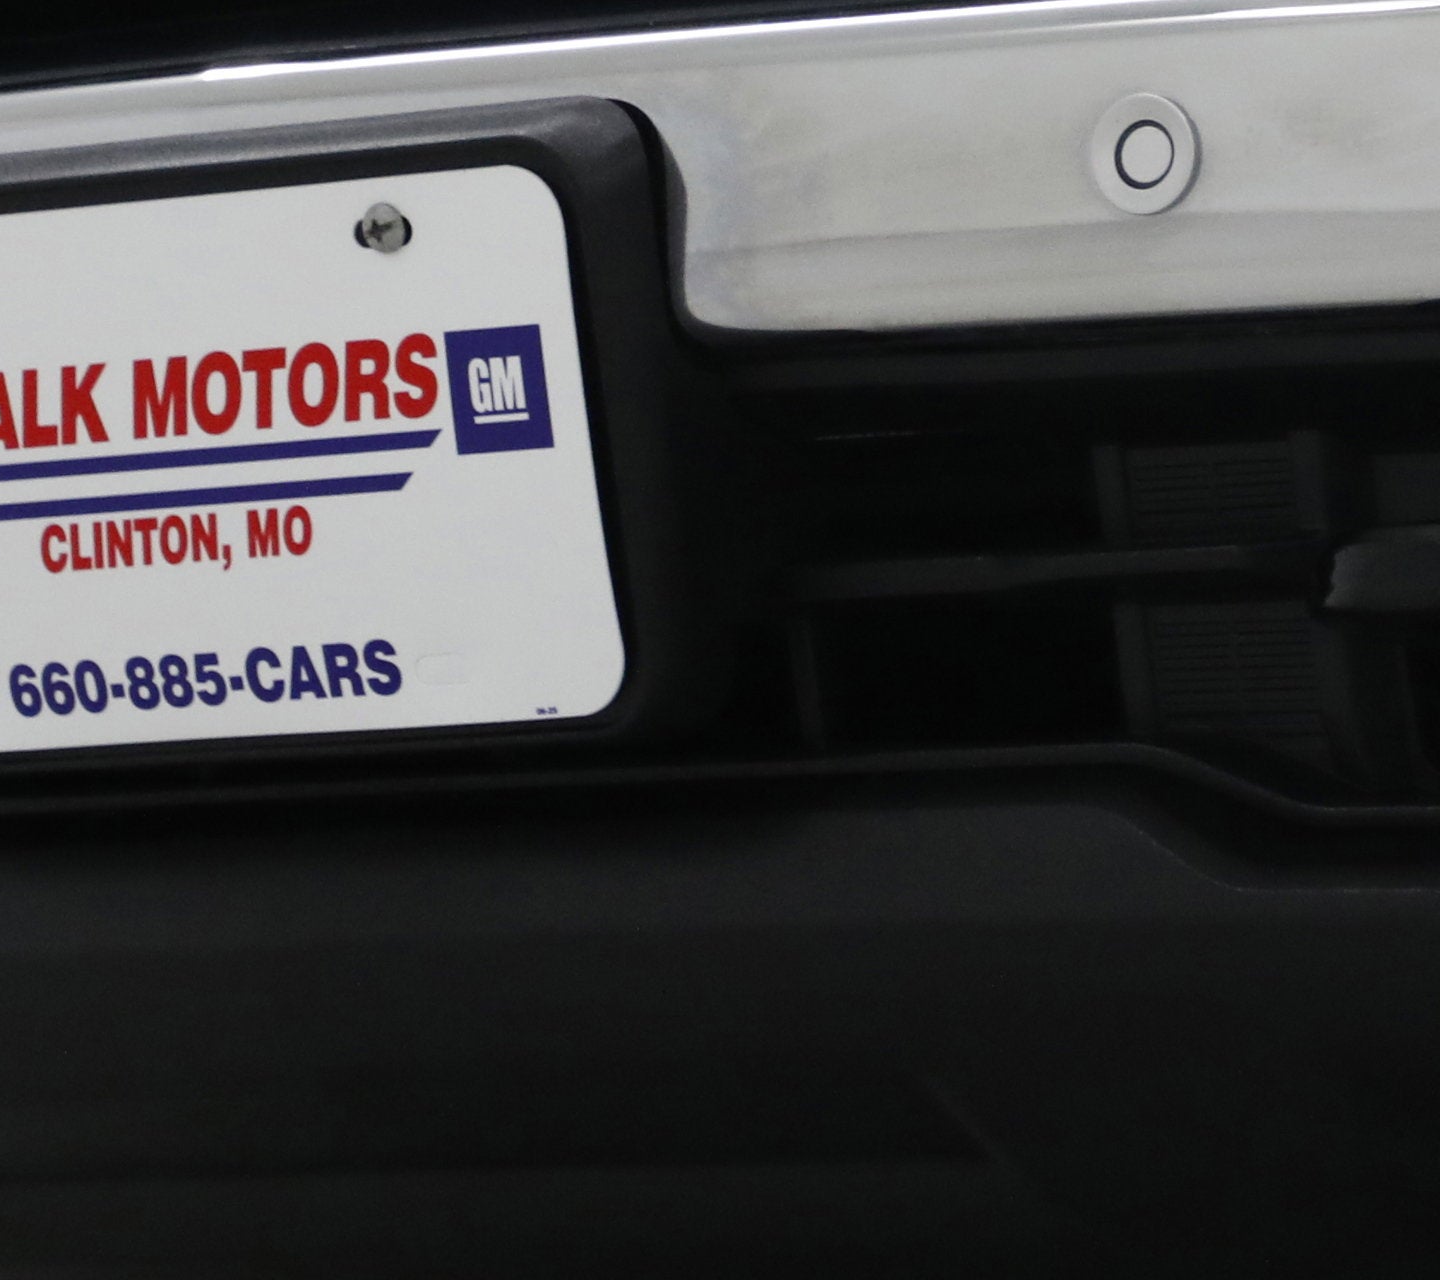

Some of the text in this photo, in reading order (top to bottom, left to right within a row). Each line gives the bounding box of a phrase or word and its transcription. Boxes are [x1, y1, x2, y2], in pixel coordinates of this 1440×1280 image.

[133, 333, 440, 439] MOTORS
[468, 355, 527, 414] GM
[41, 505, 314, 573] CLINTON, MO
[9, 639, 403, 719] 660-885-CARS
